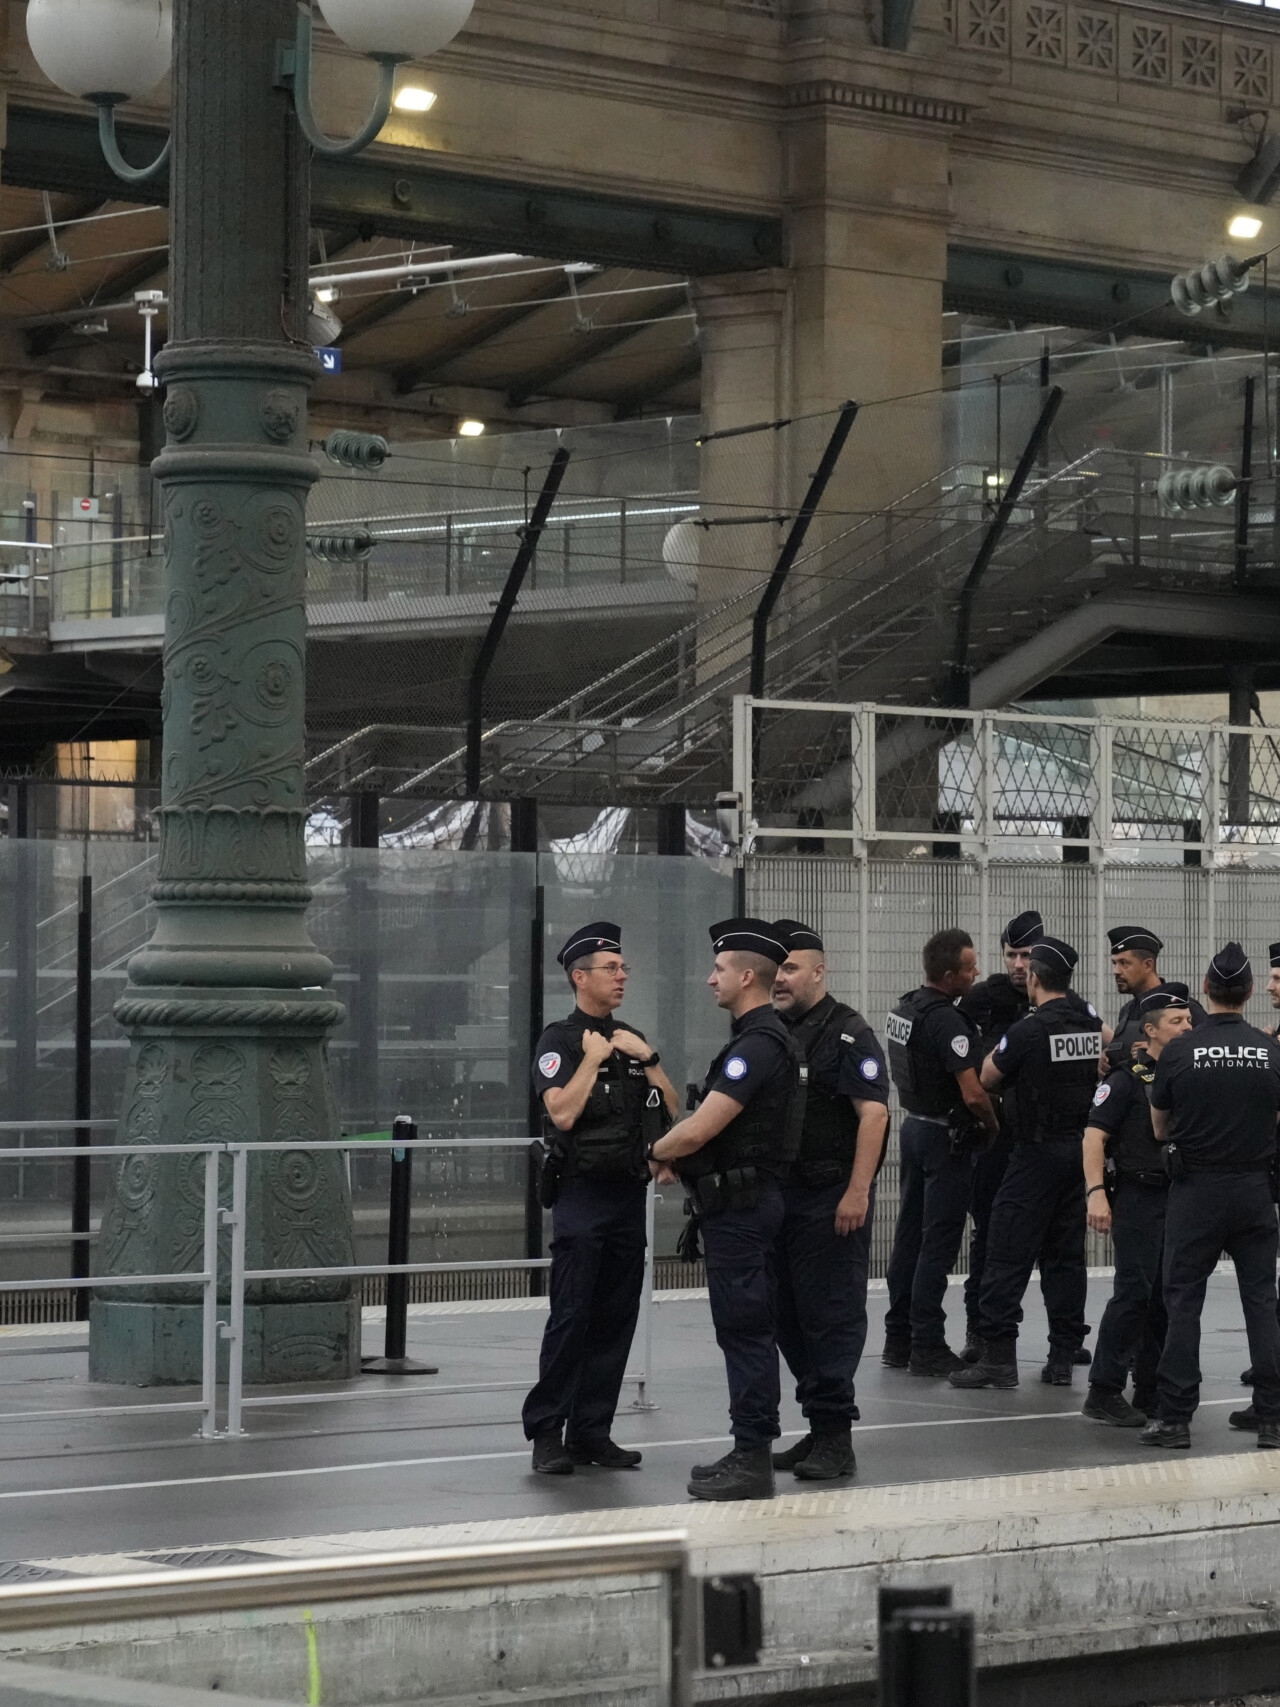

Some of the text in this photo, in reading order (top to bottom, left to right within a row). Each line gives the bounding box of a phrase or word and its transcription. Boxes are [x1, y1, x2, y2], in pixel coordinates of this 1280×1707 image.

[886, 1016, 911, 1042] POLICE
[1054, 1035, 1100, 1058] POLICE
[1193, 1045, 1269, 1060] POLICE
[1193, 1060, 1270, 1070] NATIONALE
